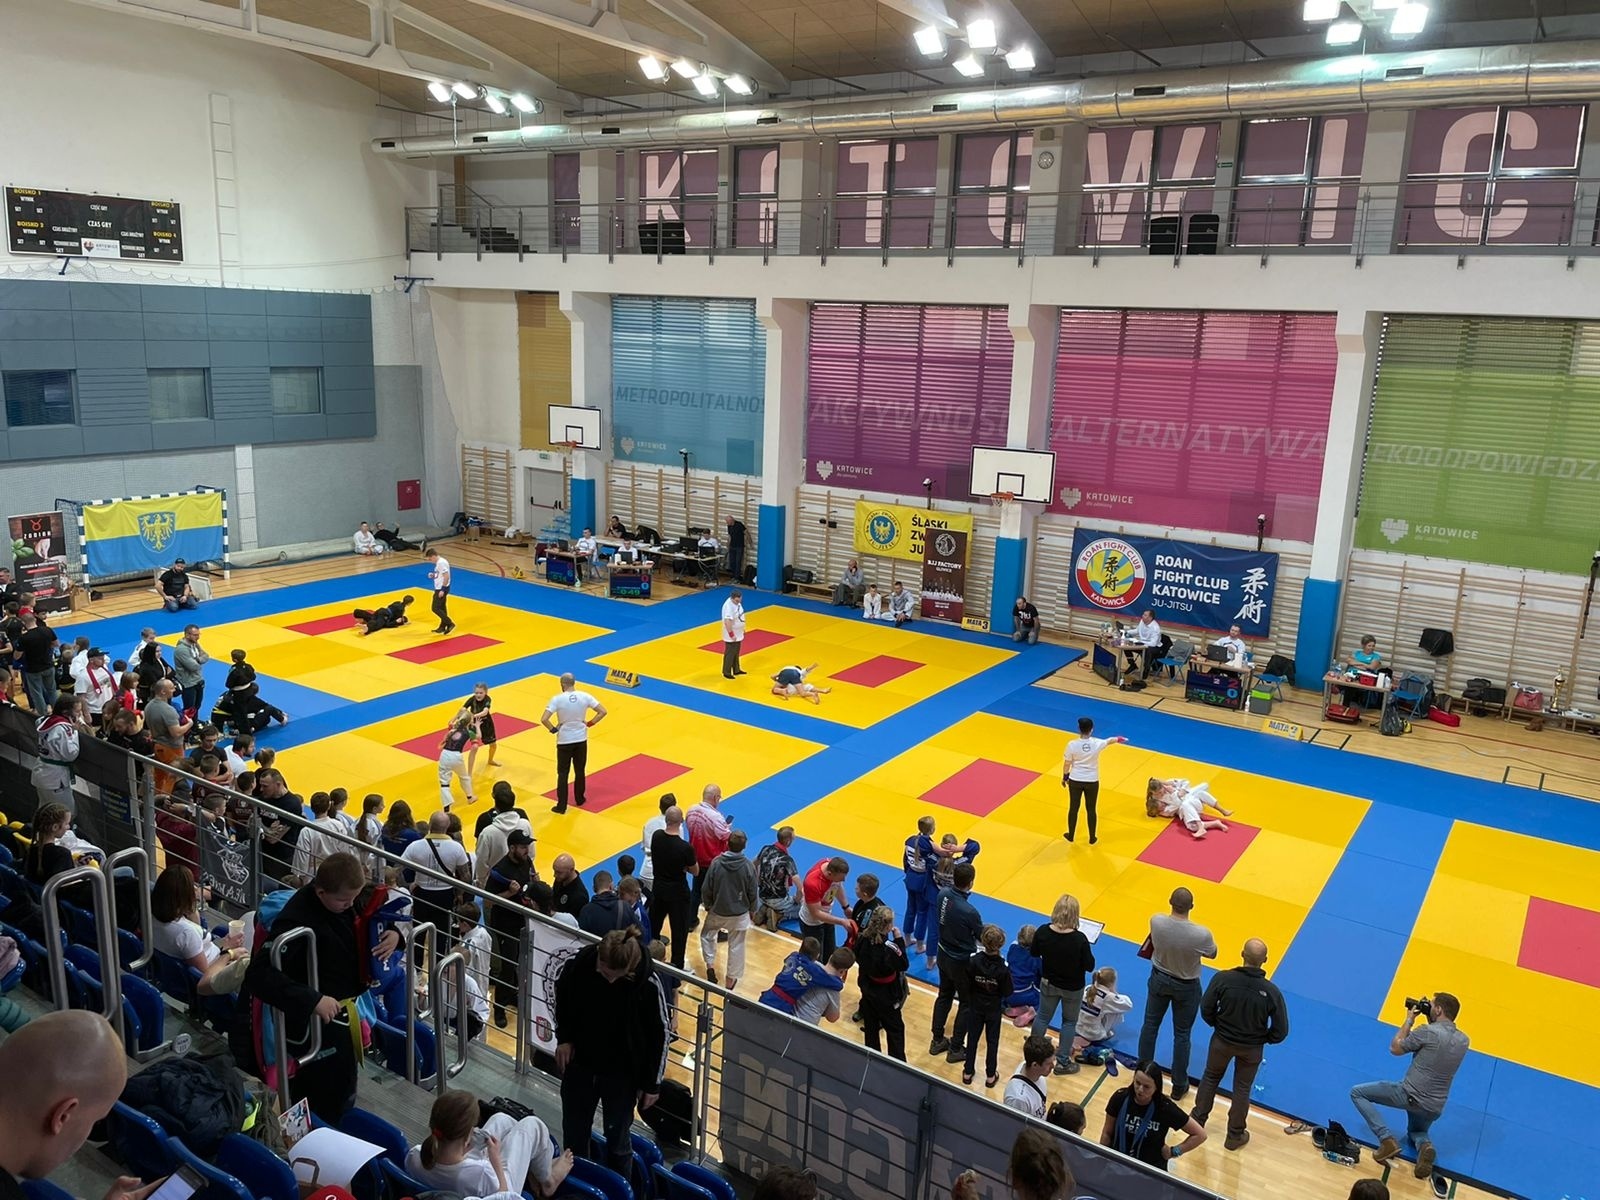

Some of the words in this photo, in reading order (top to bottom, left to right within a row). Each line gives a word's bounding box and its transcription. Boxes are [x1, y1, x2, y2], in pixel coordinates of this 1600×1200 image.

[836, 465, 873, 475] KATOWICE
[1086, 492, 1134, 504] KATOWICE
[1415, 525, 1479, 539] KATOWICE
[1103, 542, 1127, 552] FIGHT
[1126, 550, 1142, 570] CLUB
[1155, 554, 1193, 570] ROAN
[937, 560, 962, 570] FACTORY
[1153, 569, 1193, 585] FIGHT
[1194, 575, 1230, 591] CLUB
[1090, 593, 1126, 606] KATOWICE
[1152, 584, 1222, 605] KATOWICE
[1151, 598, 1193, 612] JU-JITSU
[966, 618, 982, 627] MATA
[982, 620, 989, 630] 3
[610, 668, 627, 679] MATA
[625, 672, 634, 684] 4
[1268, 720, 1290, 733] MATA
